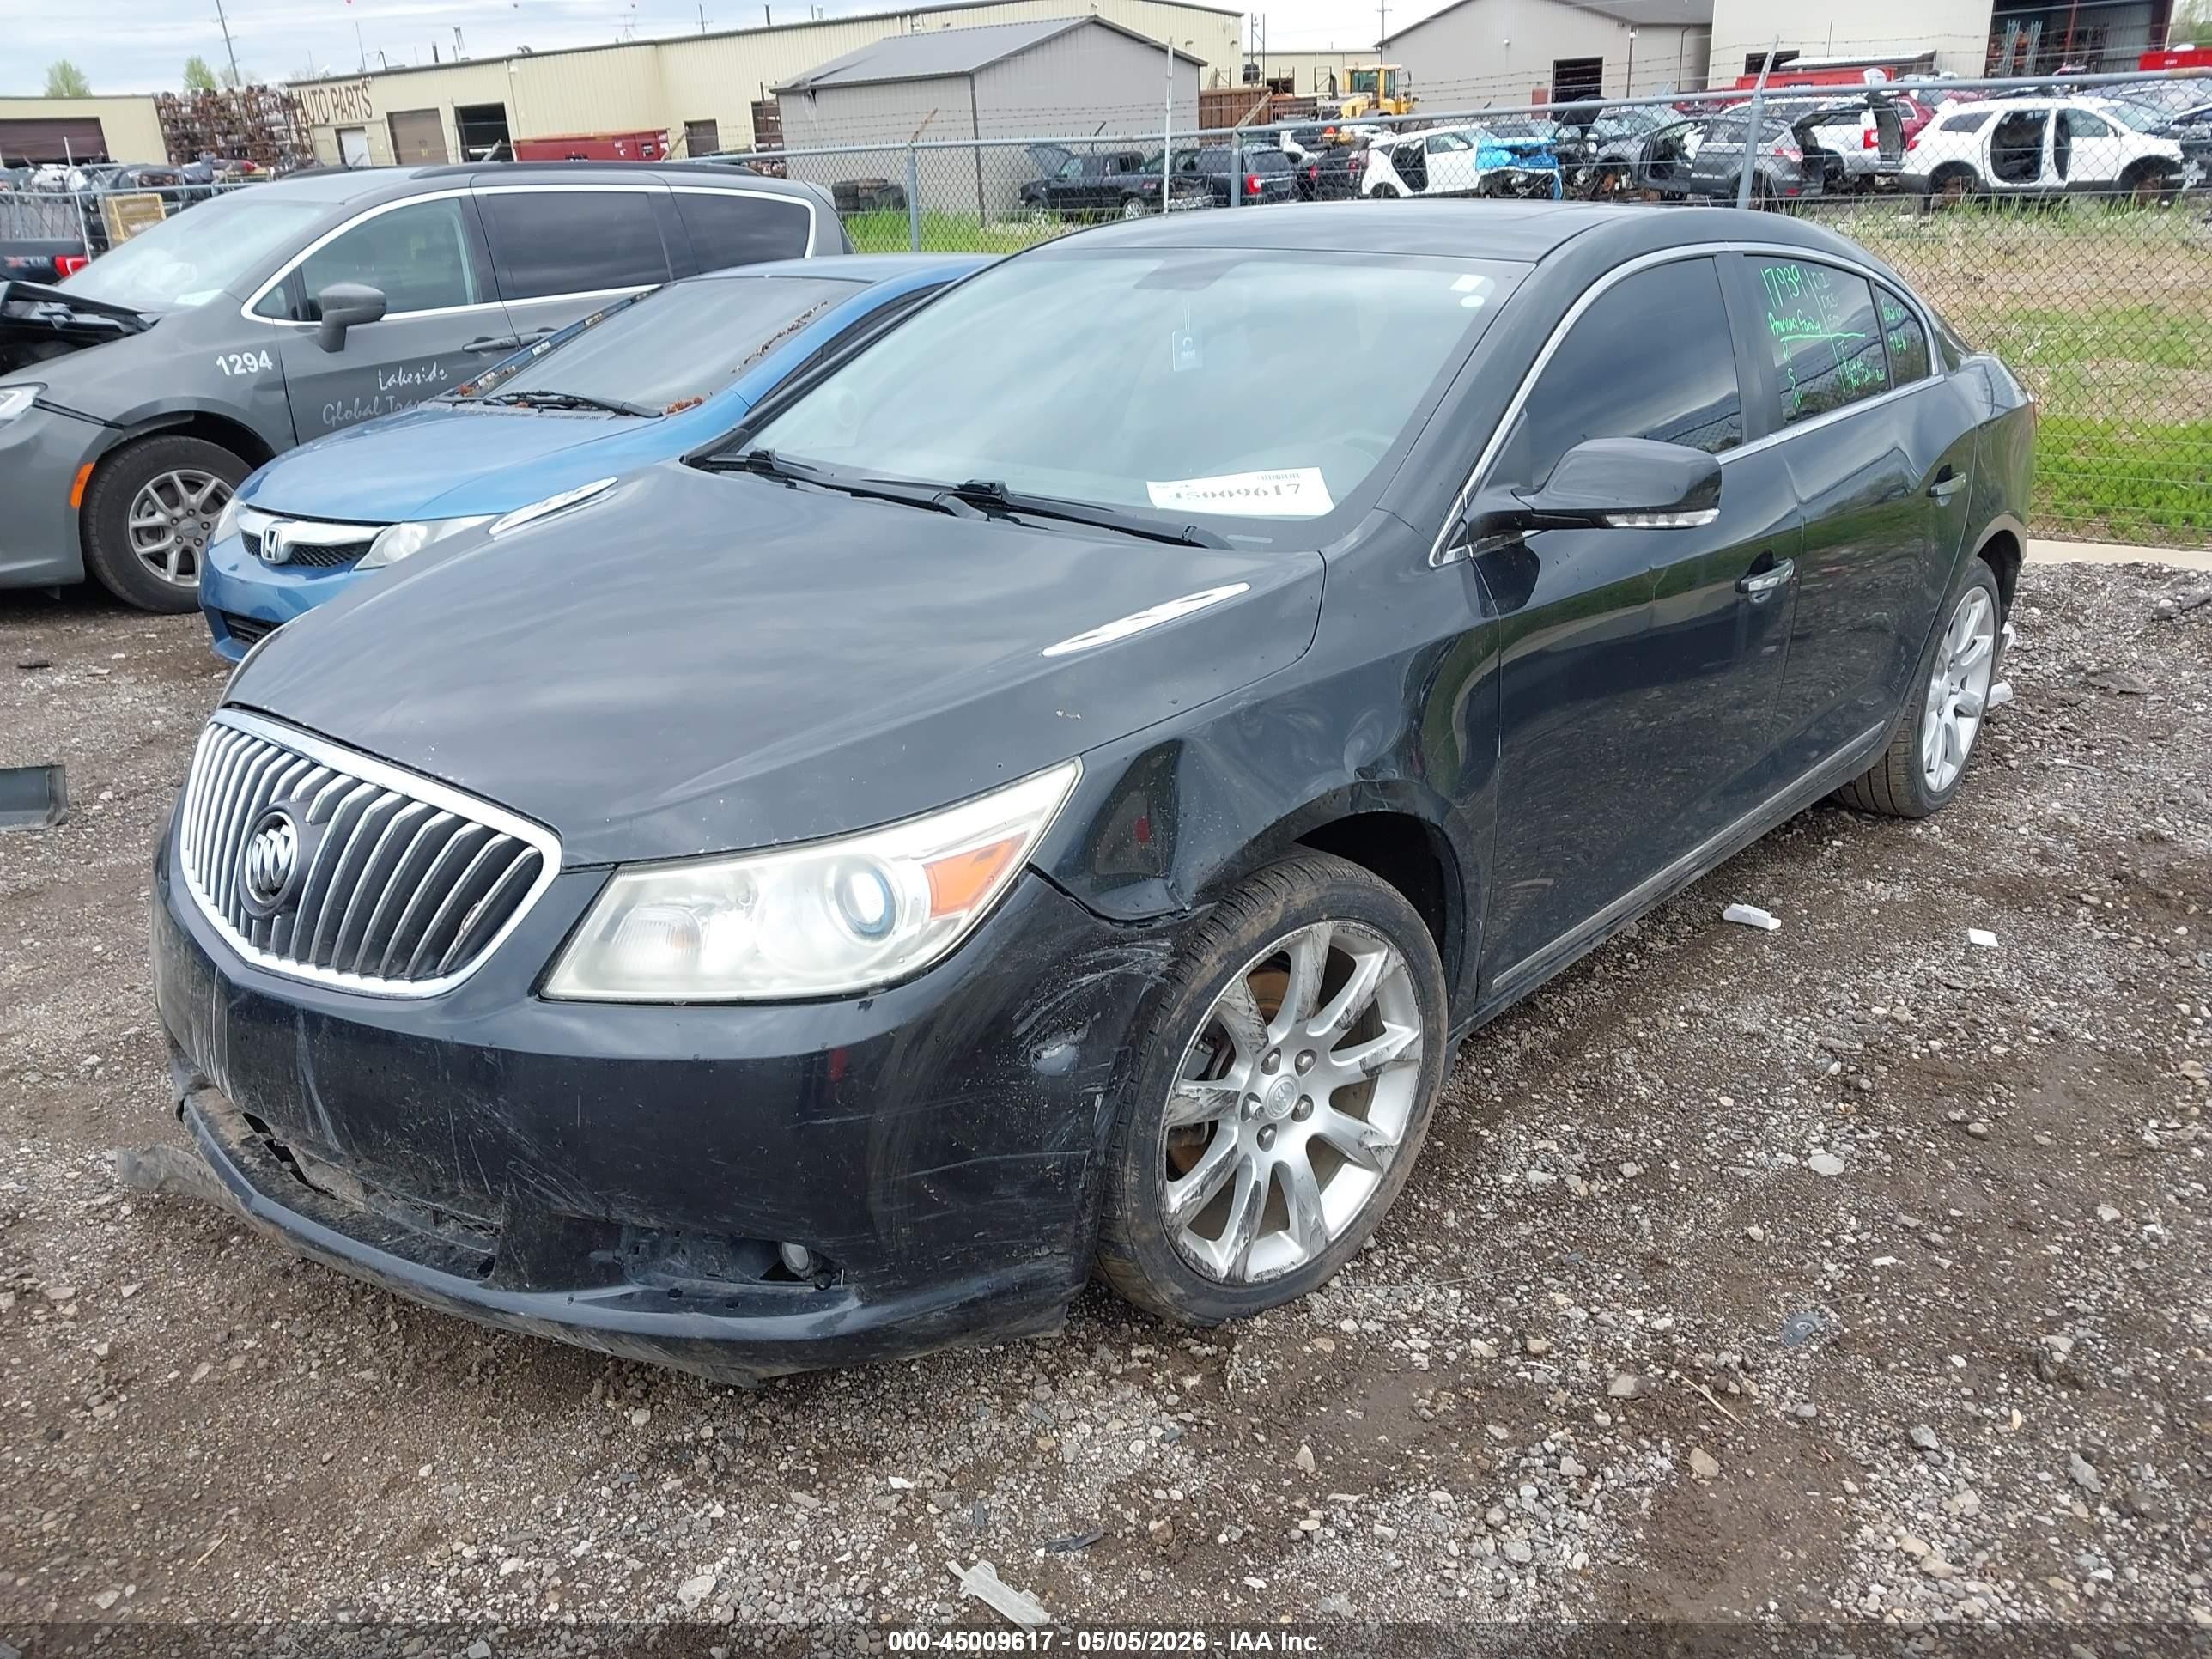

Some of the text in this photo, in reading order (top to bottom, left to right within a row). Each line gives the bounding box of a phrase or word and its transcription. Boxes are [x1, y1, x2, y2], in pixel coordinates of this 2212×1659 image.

[330, 82, 372, 121] PARTS
[216, 350, 273, 376] 1294
[379, 362, 447, 391] Lakeside
[323, 396, 383, 426] Global
